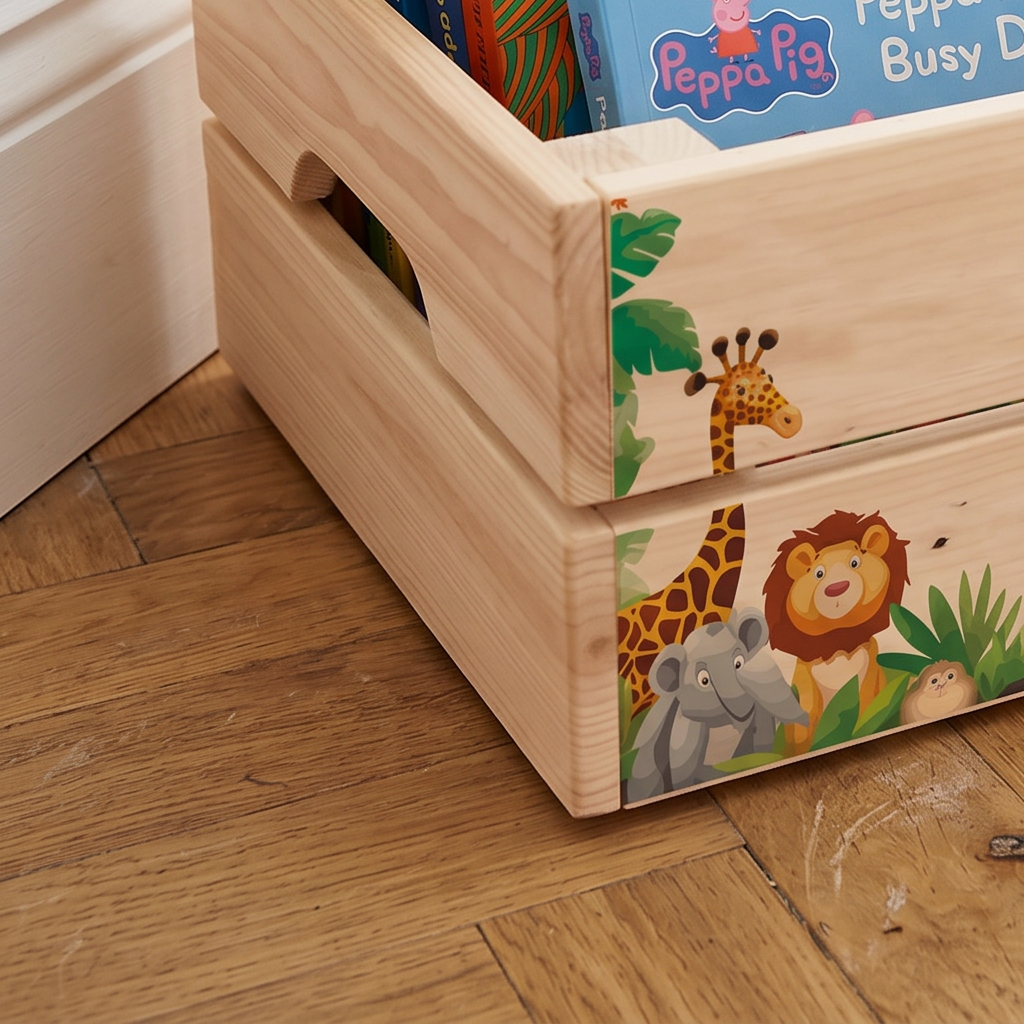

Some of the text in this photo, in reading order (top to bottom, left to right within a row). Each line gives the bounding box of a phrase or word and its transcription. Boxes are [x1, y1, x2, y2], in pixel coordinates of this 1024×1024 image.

[659, 41, 771, 109] Peppa
[771, 23, 834, 82] Pig
[881, 36, 981, 82] Busy
